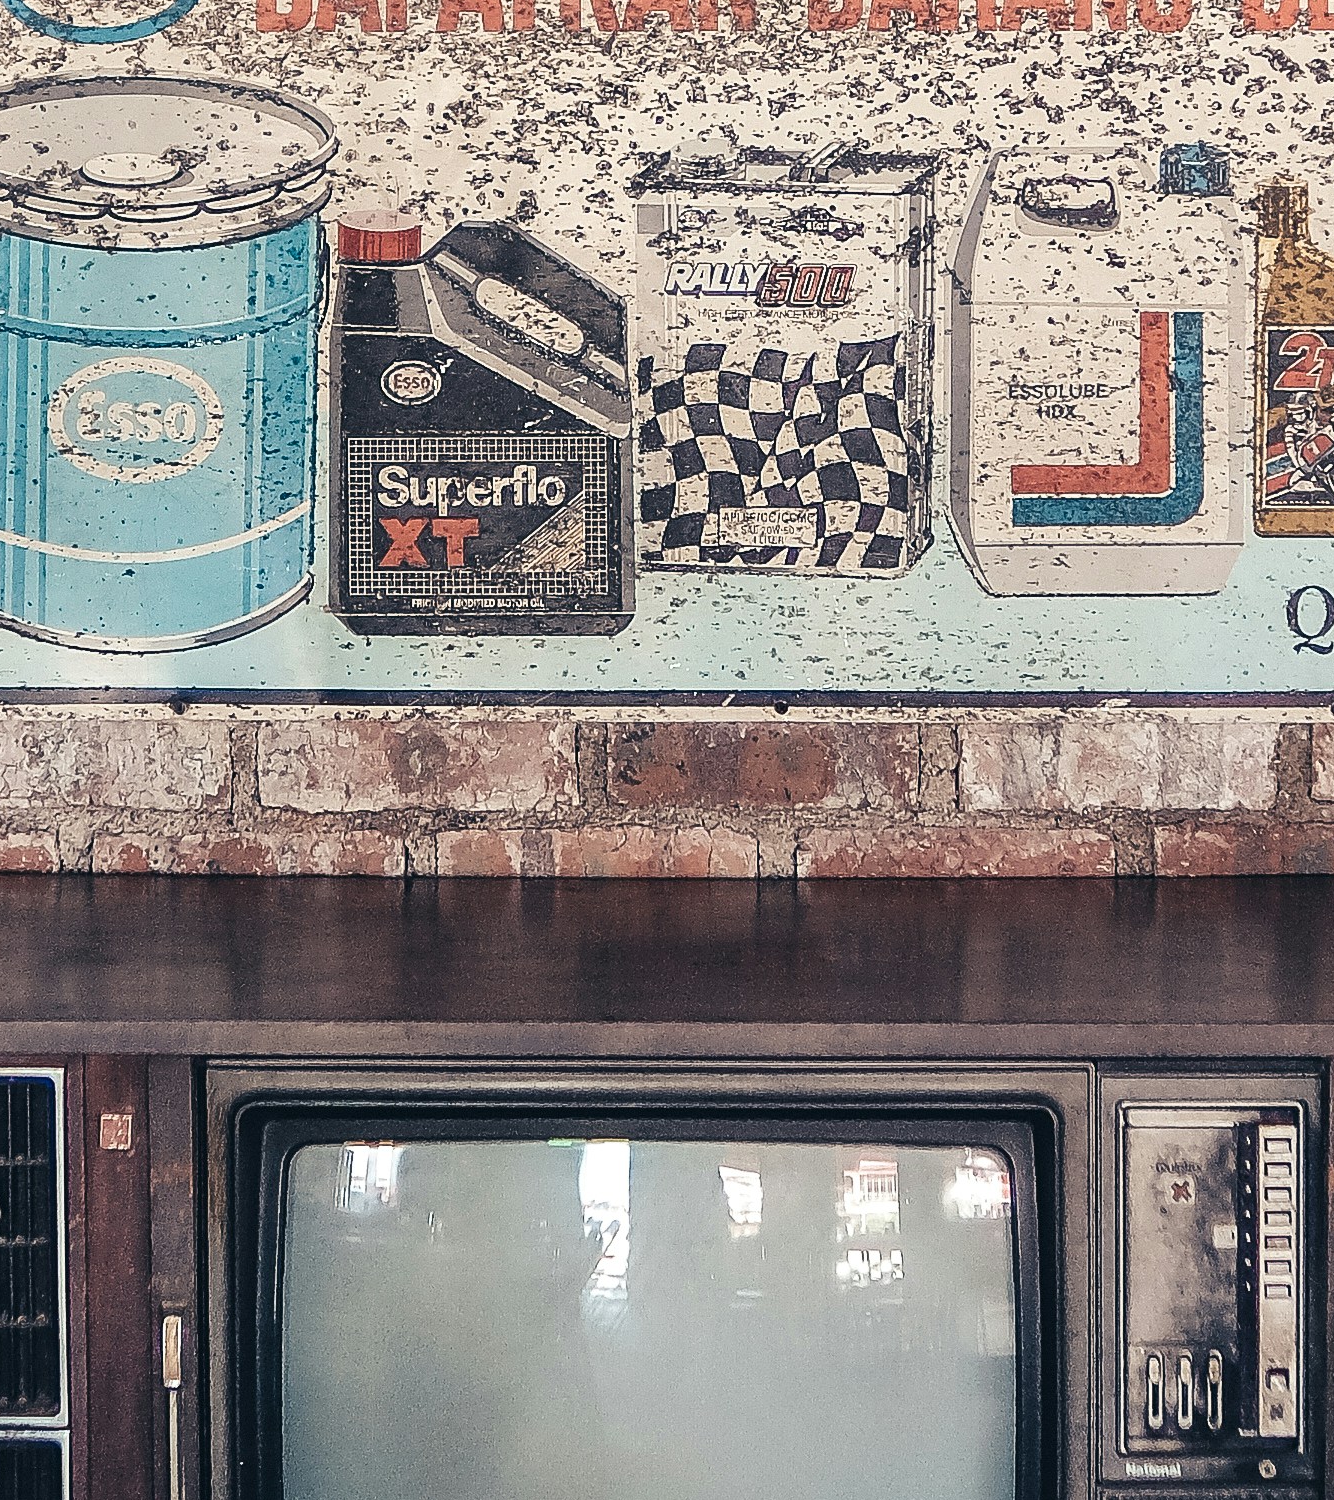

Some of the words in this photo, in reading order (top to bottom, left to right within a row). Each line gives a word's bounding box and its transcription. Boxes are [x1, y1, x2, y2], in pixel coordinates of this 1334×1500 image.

[665, 262, 767, 297] RALLY
[756, 262, 858, 308] 500
[392, 373, 431, 390] Esso
[1008, 383, 1110, 400] ESSOLUBE
[72, 391, 200, 447] Esso
[377, 464, 567, 517] Superflo
[378, 517, 481, 568] XT
